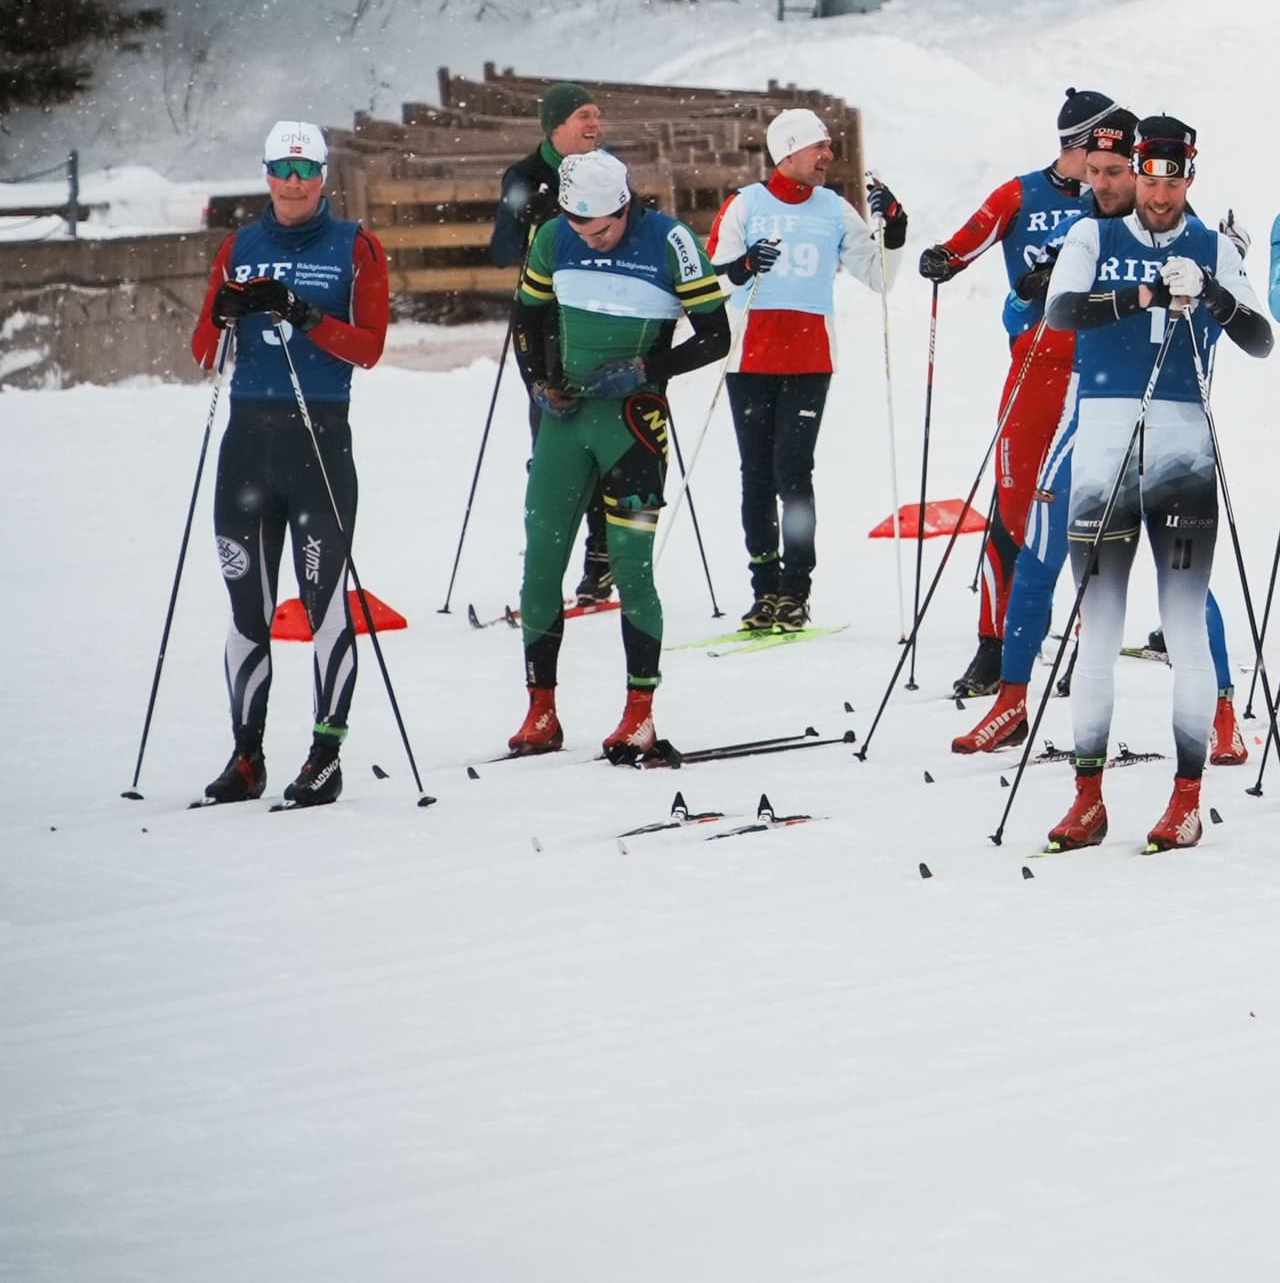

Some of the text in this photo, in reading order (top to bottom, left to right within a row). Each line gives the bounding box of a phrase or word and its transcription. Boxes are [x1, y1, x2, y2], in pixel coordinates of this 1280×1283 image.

[670, 232, 688, 264] SWECO
[296, 261, 342, 273] Rådgivende
[1098, 257, 1163, 283] RIF
[293, 278, 330, 289] Forening
[302, 534, 323, 584] swix
[974, 698, 1026, 747] alpina
